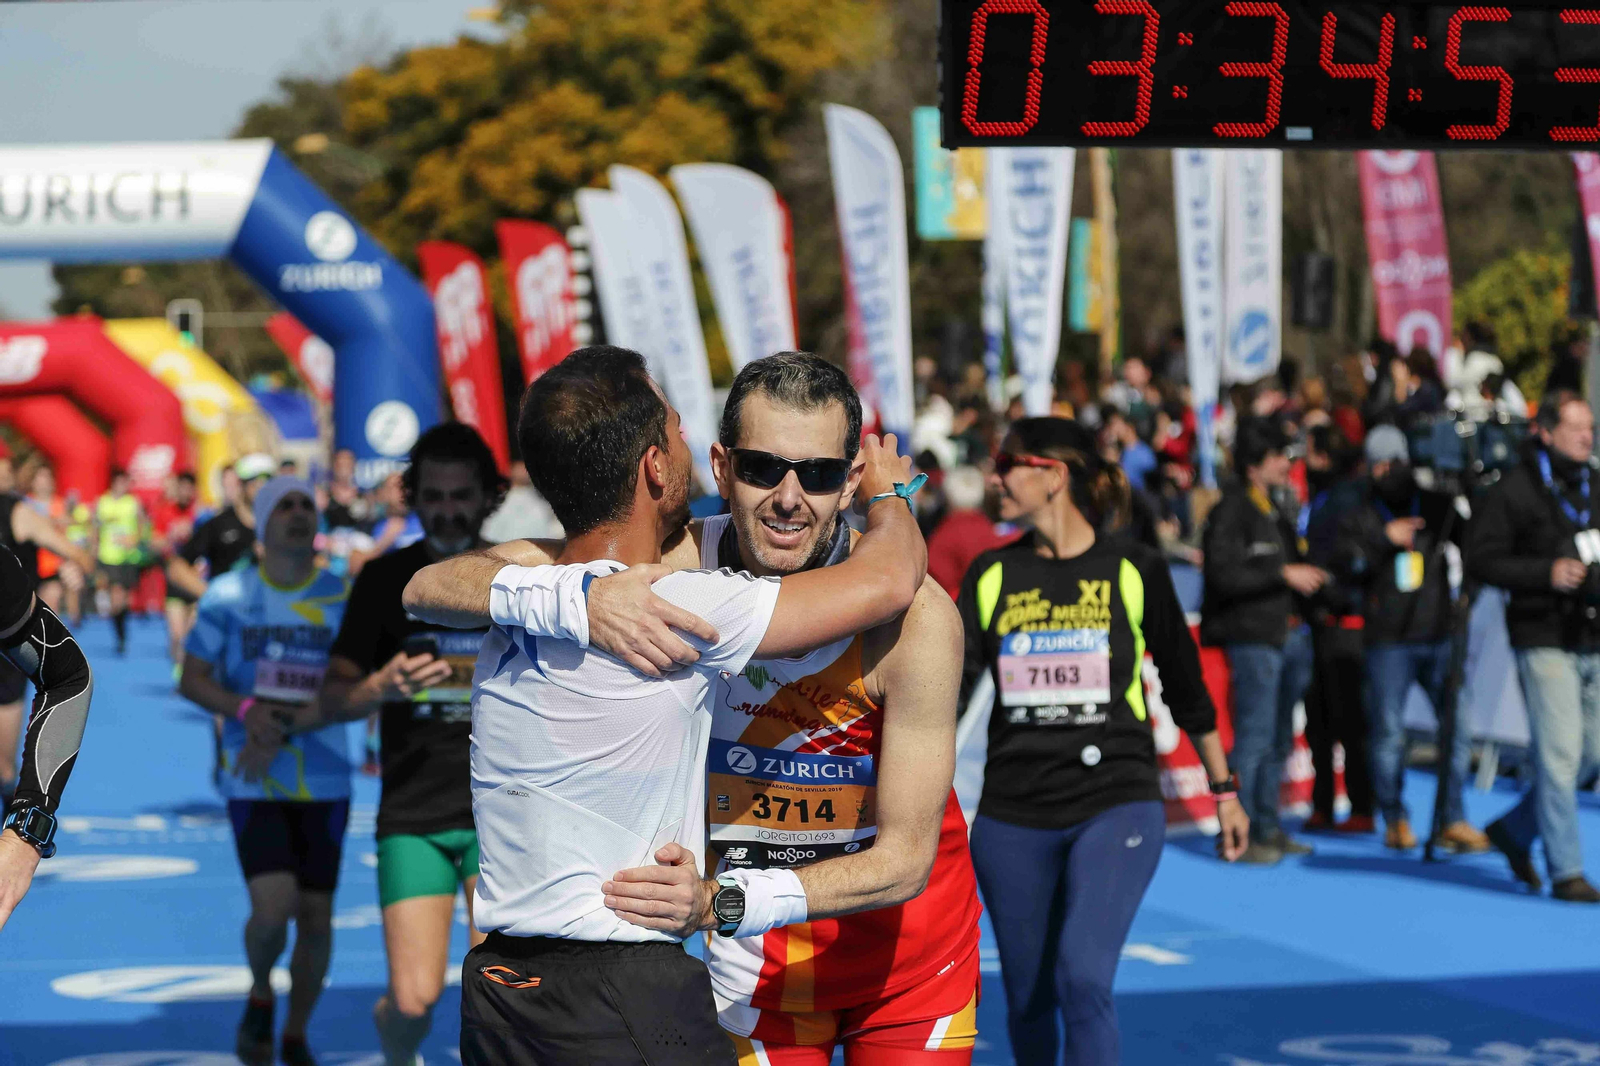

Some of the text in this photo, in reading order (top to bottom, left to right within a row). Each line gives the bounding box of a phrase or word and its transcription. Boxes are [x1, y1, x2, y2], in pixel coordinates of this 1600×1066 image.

[279, 260, 383, 293] ZURICH
[1078, 580, 1111, 606] XI
[1051, 605, 1112, 621] MEDIA
[1035, 634, 1096, 651] ZURICH
[1028, 665, 1080, 685] 7163
[762, 757, 855, 779] ZURICH
[752, 792, 836, 824] 3714
[755, 829, 836, 843] JORGITO1693
